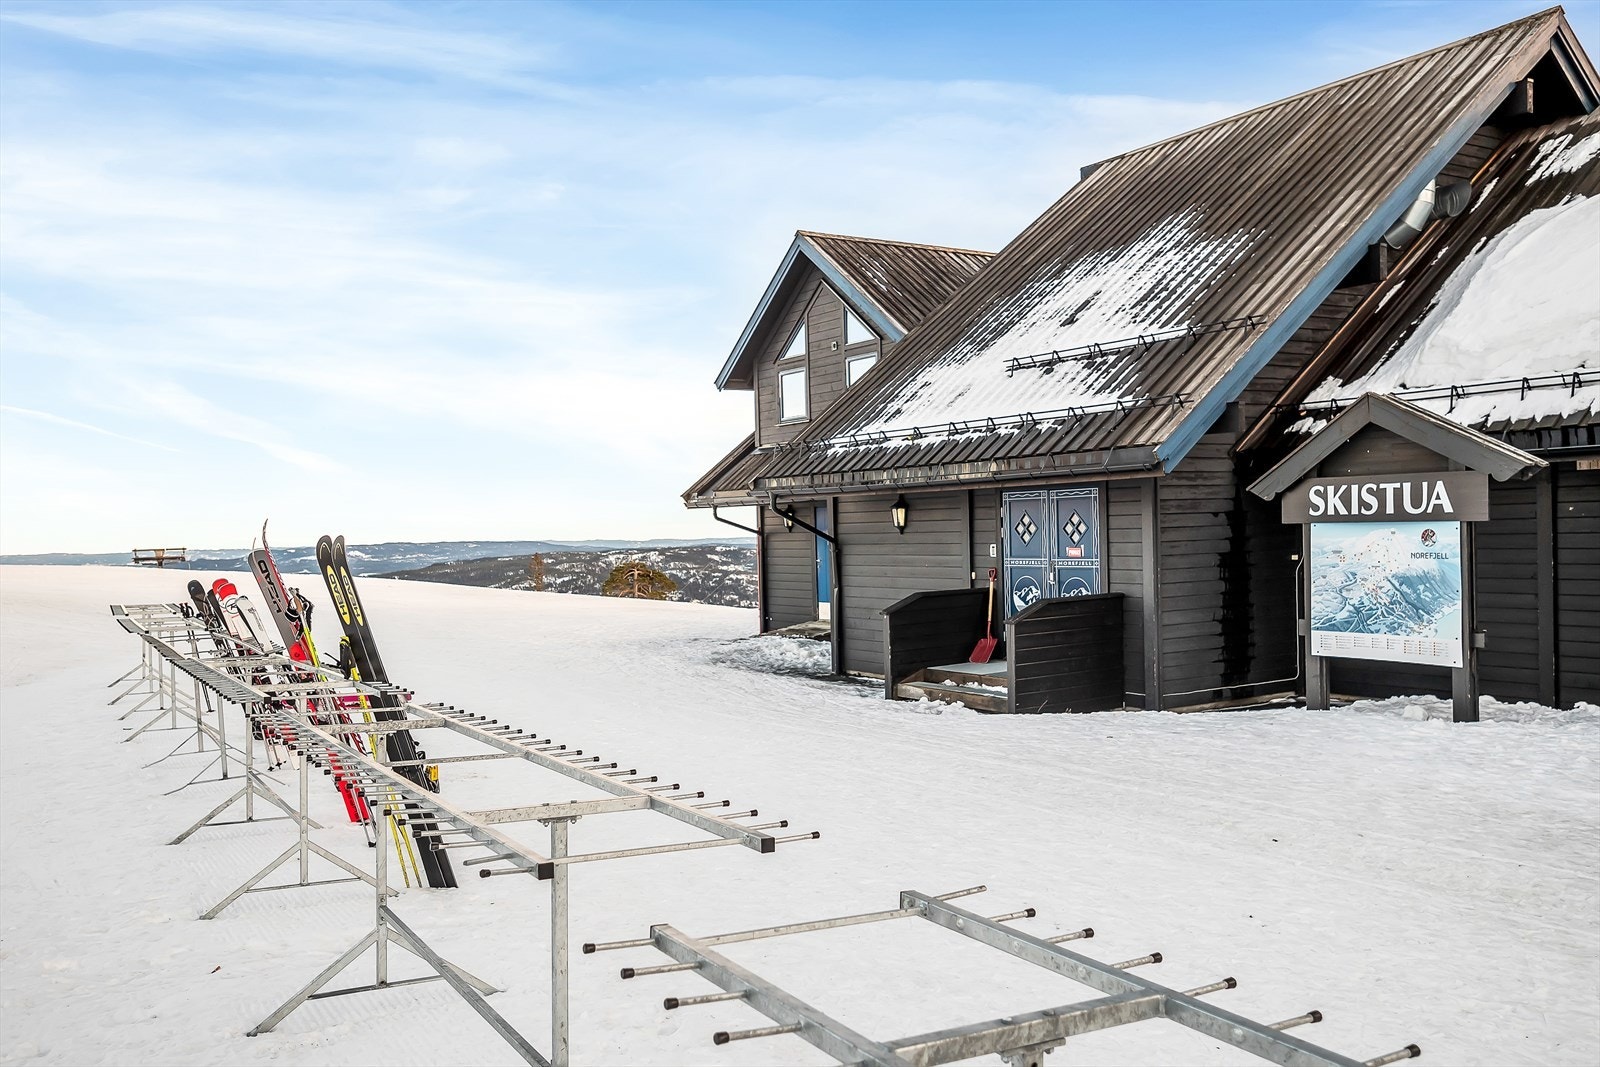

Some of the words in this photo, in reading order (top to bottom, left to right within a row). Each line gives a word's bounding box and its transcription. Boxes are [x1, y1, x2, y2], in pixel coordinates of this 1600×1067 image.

[1308, 480, 1454, 516] SKISTUA
[1410, 552, 1449, 560] NOREFJELL
[258, 560, 282, 613] HEAD
[329, 573, 347, 616] HEAD
[343, 575, 361, 618] HEAD
